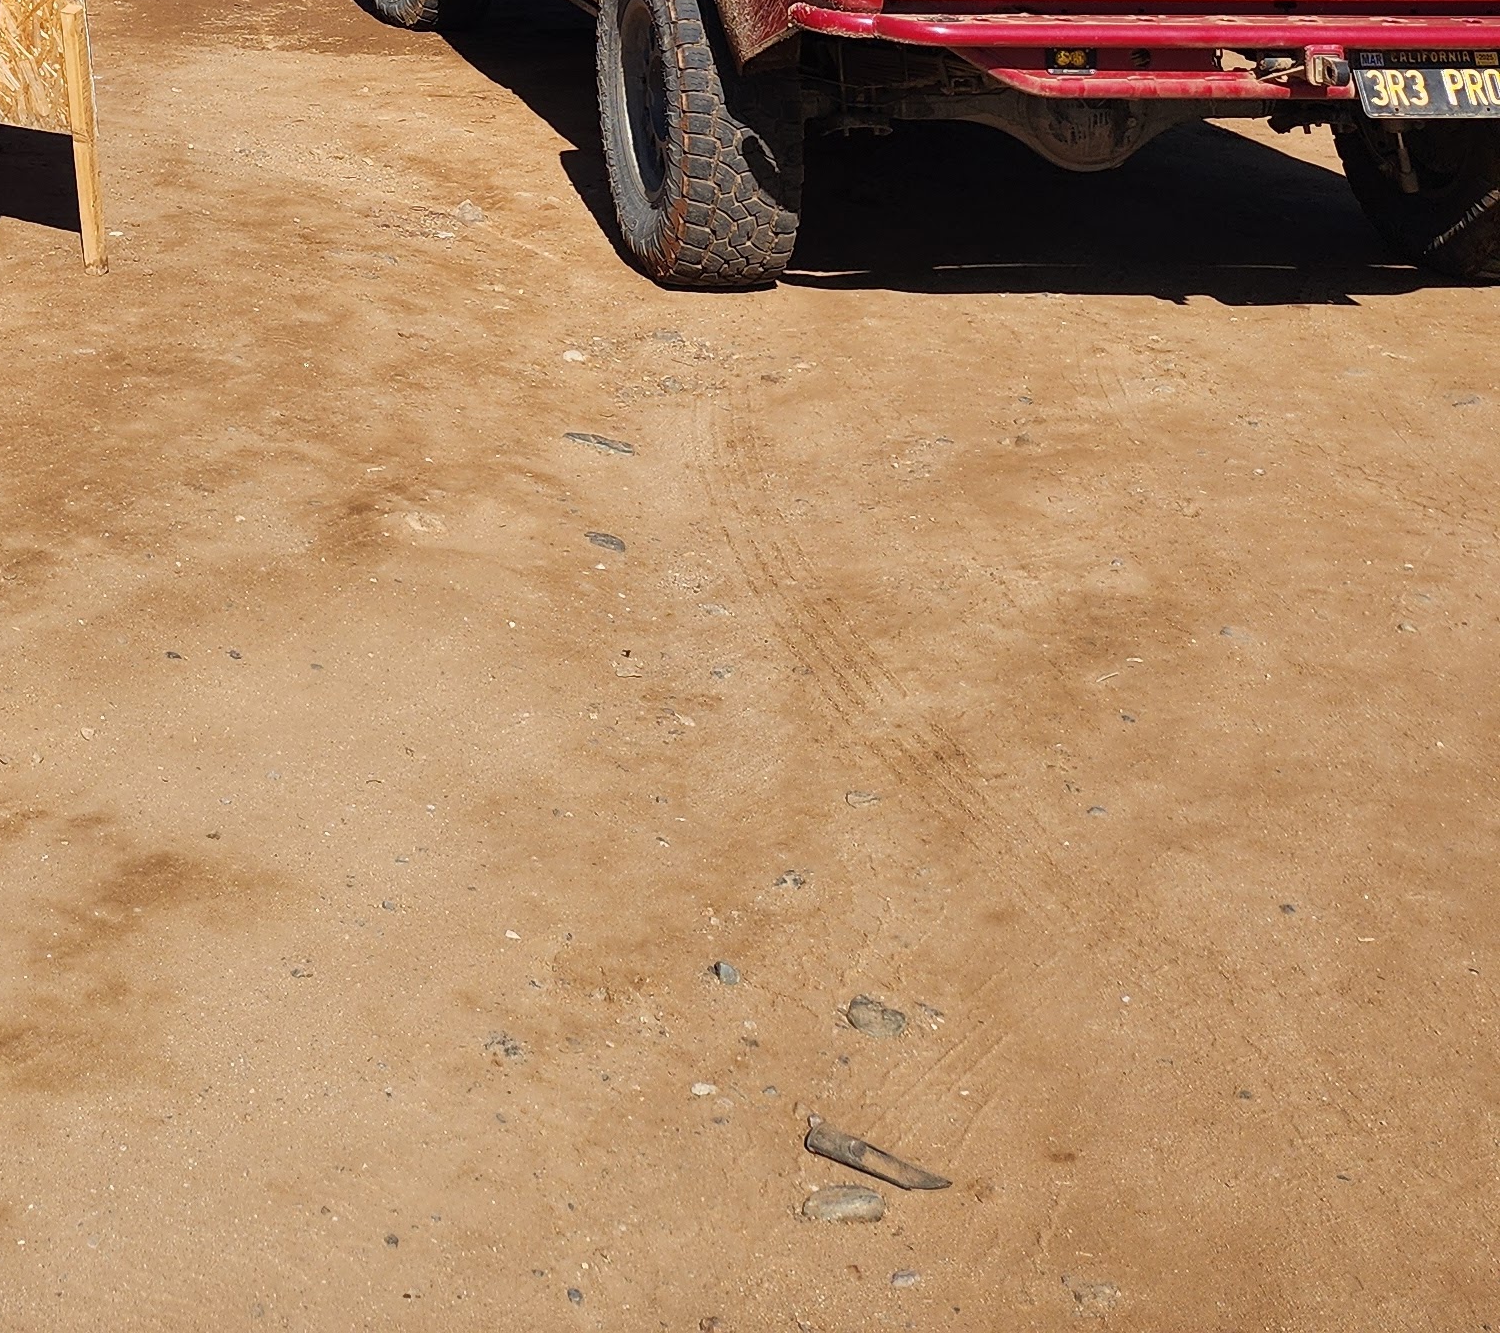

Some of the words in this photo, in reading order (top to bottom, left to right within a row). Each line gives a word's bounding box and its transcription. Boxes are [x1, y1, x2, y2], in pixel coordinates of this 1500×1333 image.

[1361, 54, 1383, 66] MAR
[1391, 51, 1471, 63] CALIFORNIA
[1366, 69, 1429, 106] 3R3
